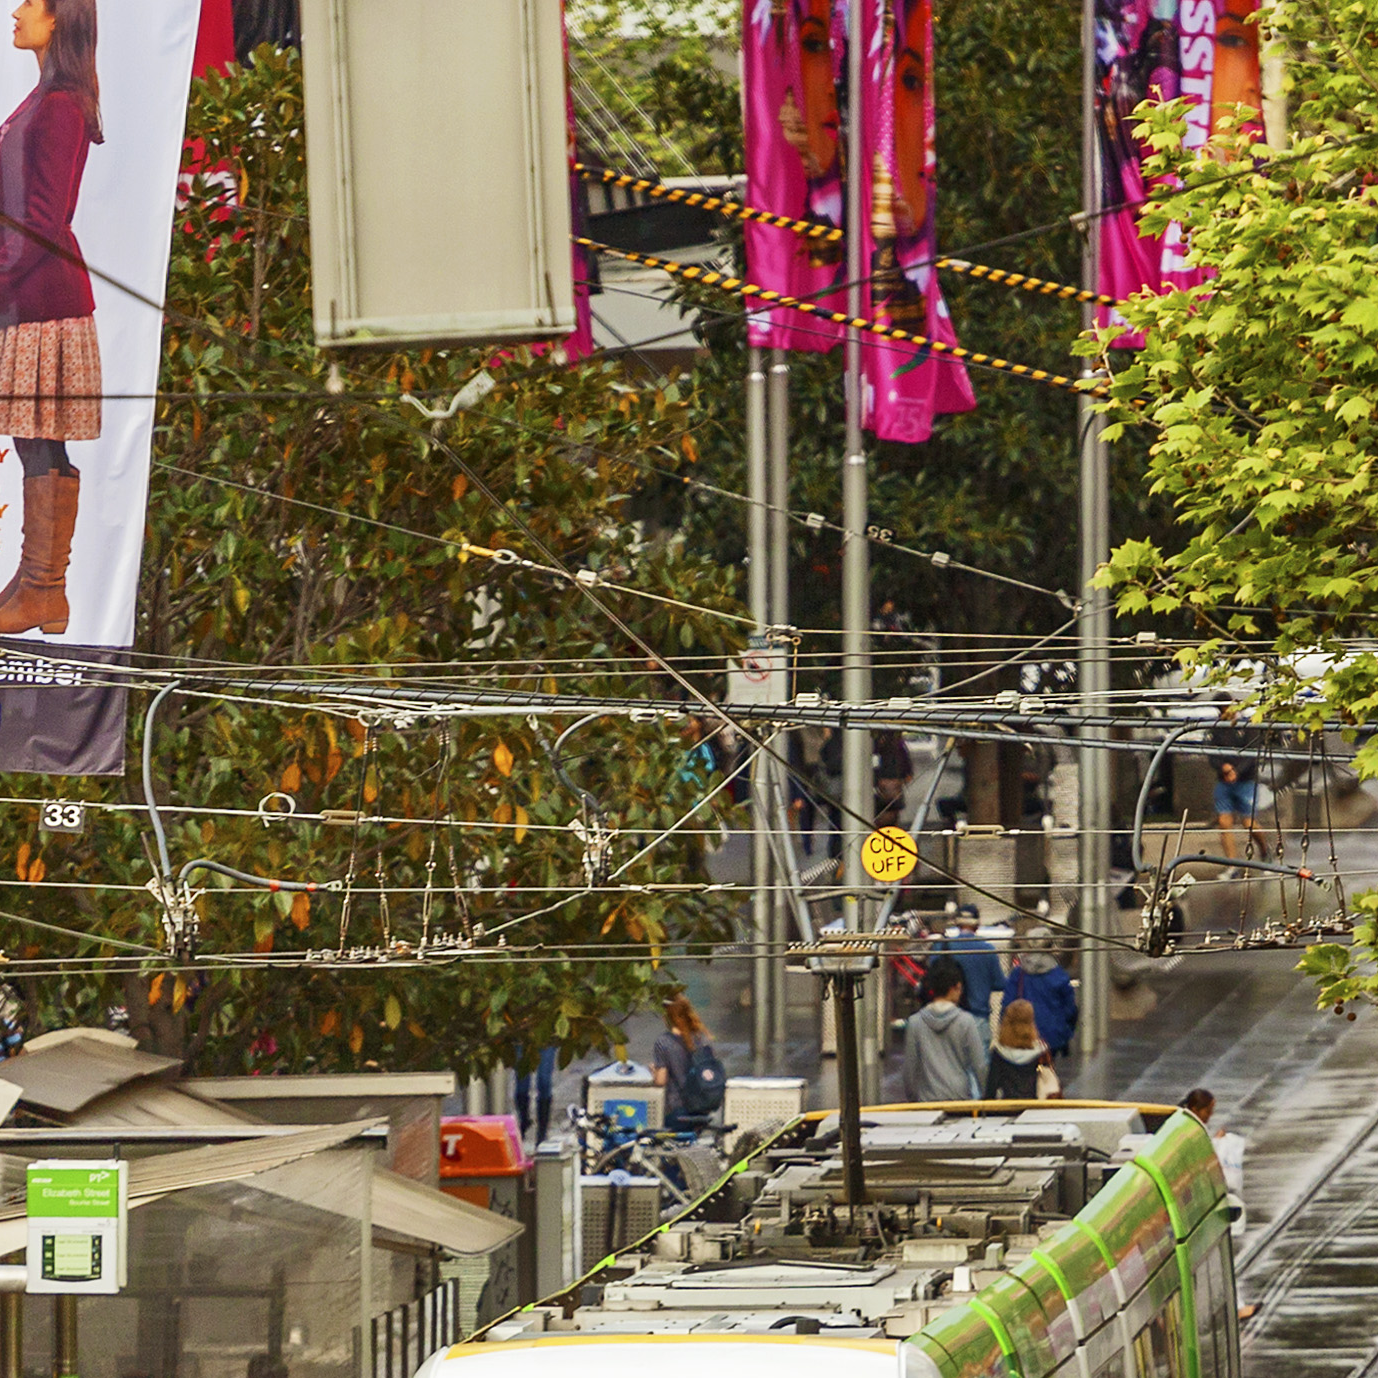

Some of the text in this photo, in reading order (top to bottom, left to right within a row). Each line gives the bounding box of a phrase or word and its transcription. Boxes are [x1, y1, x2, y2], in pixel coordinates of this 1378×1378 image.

[44, 804, 81, 828] 33
[872, 855, 906, 874] OFF
[42, 1188, 110, 1198] Elizabeth Street
